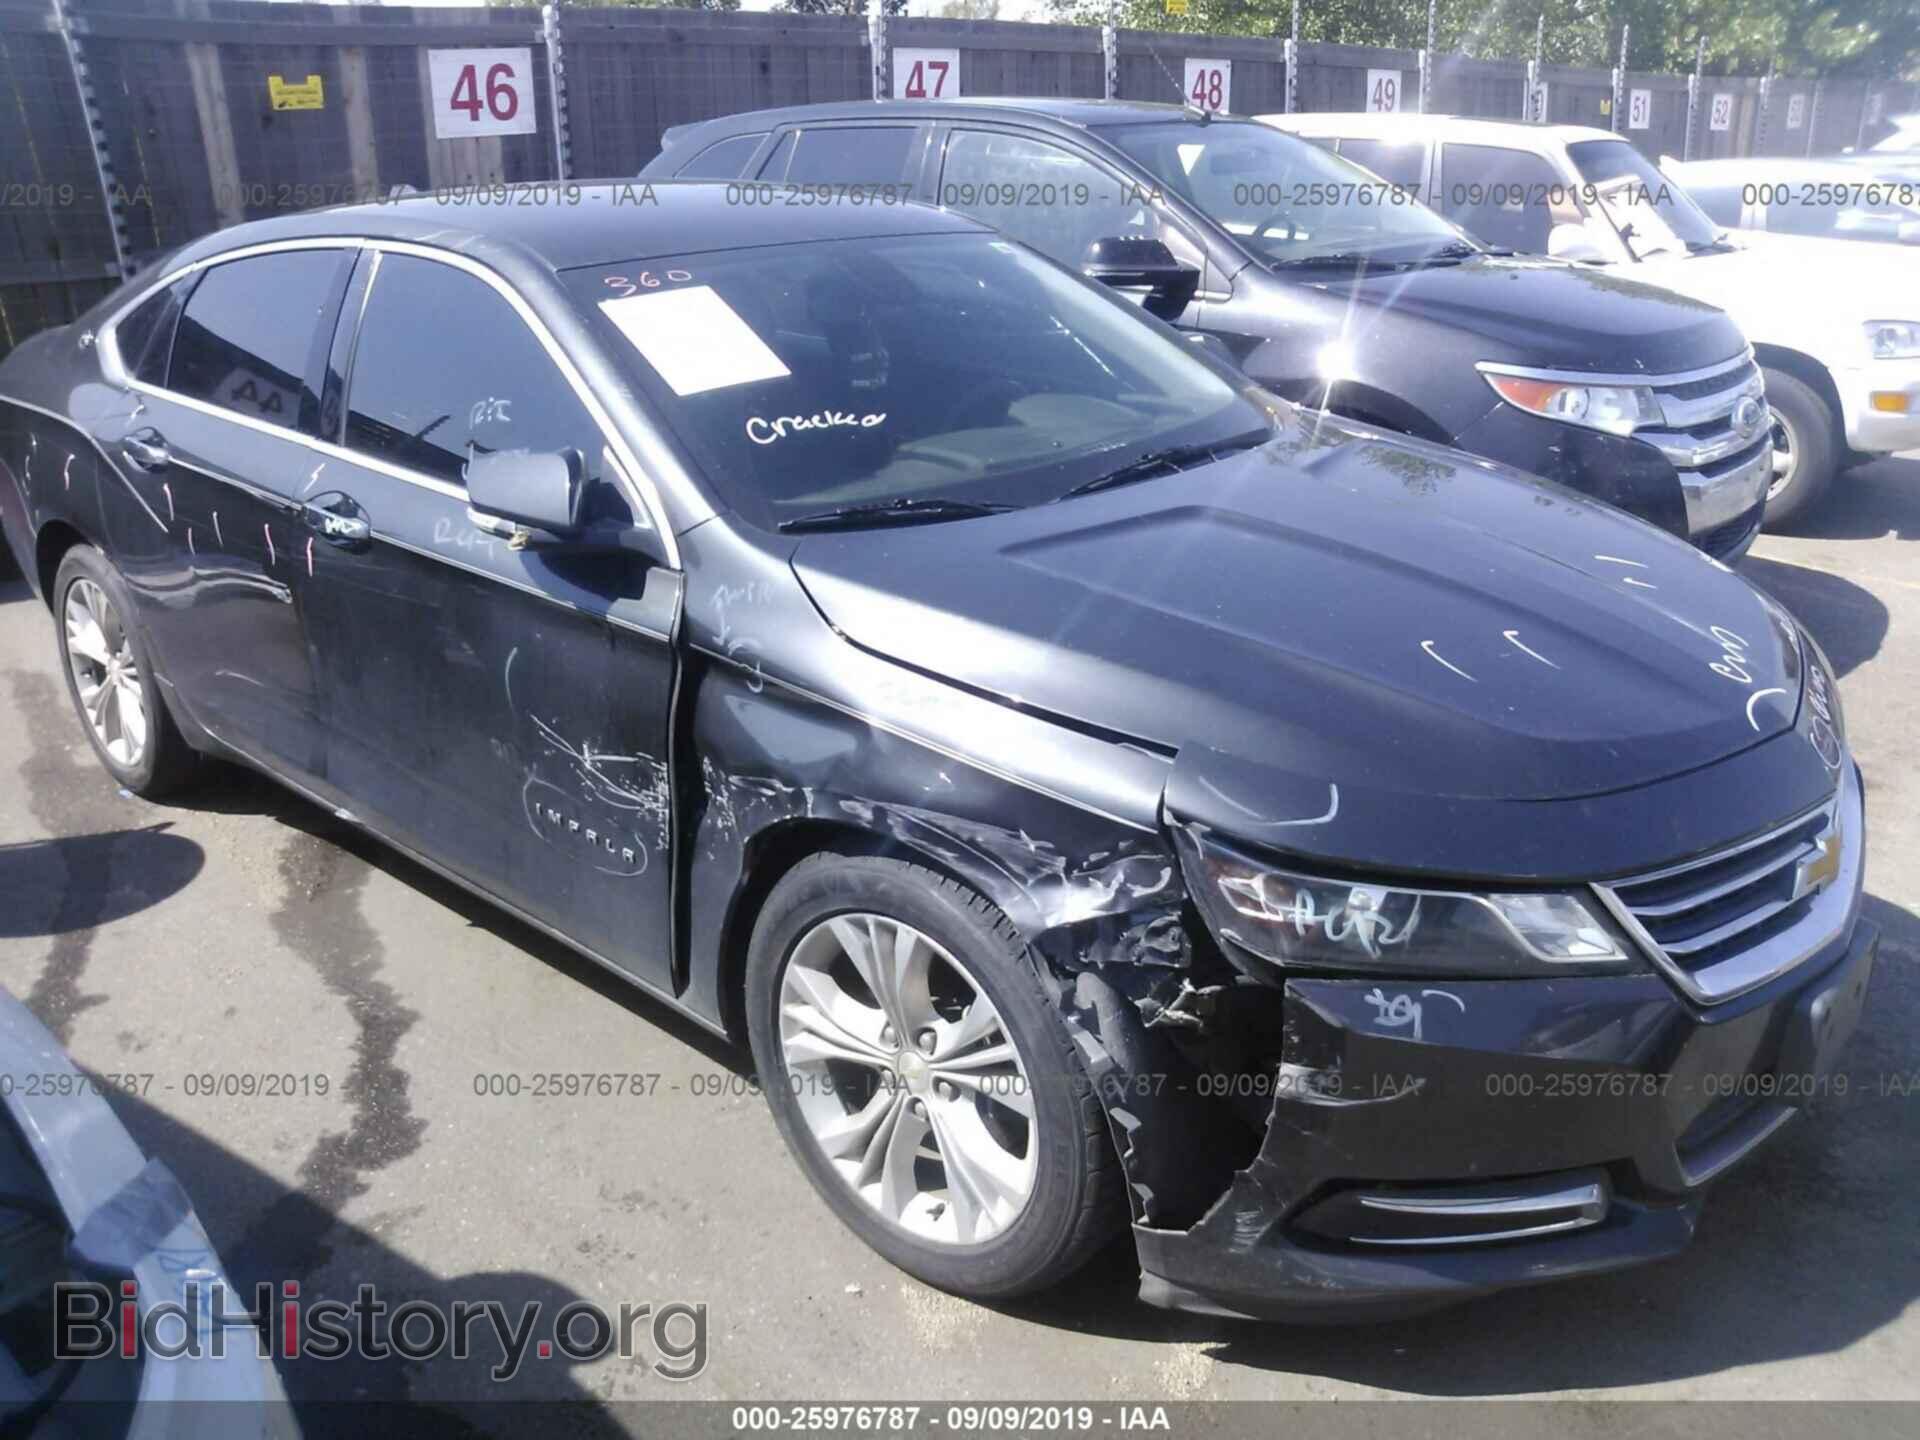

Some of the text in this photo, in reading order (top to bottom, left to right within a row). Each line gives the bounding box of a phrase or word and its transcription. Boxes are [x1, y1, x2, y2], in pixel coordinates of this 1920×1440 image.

[450, 63, 519, 122] 46
[905, 60, 950, 98] 47
[1192, 69, 1223, 110] 48
[1372, 78, 1396, 112] 49
[1632, 96, 1647, 122] 51
[1713, 100, 1729, 125] 52
[604, 269, 693, 297] 360
